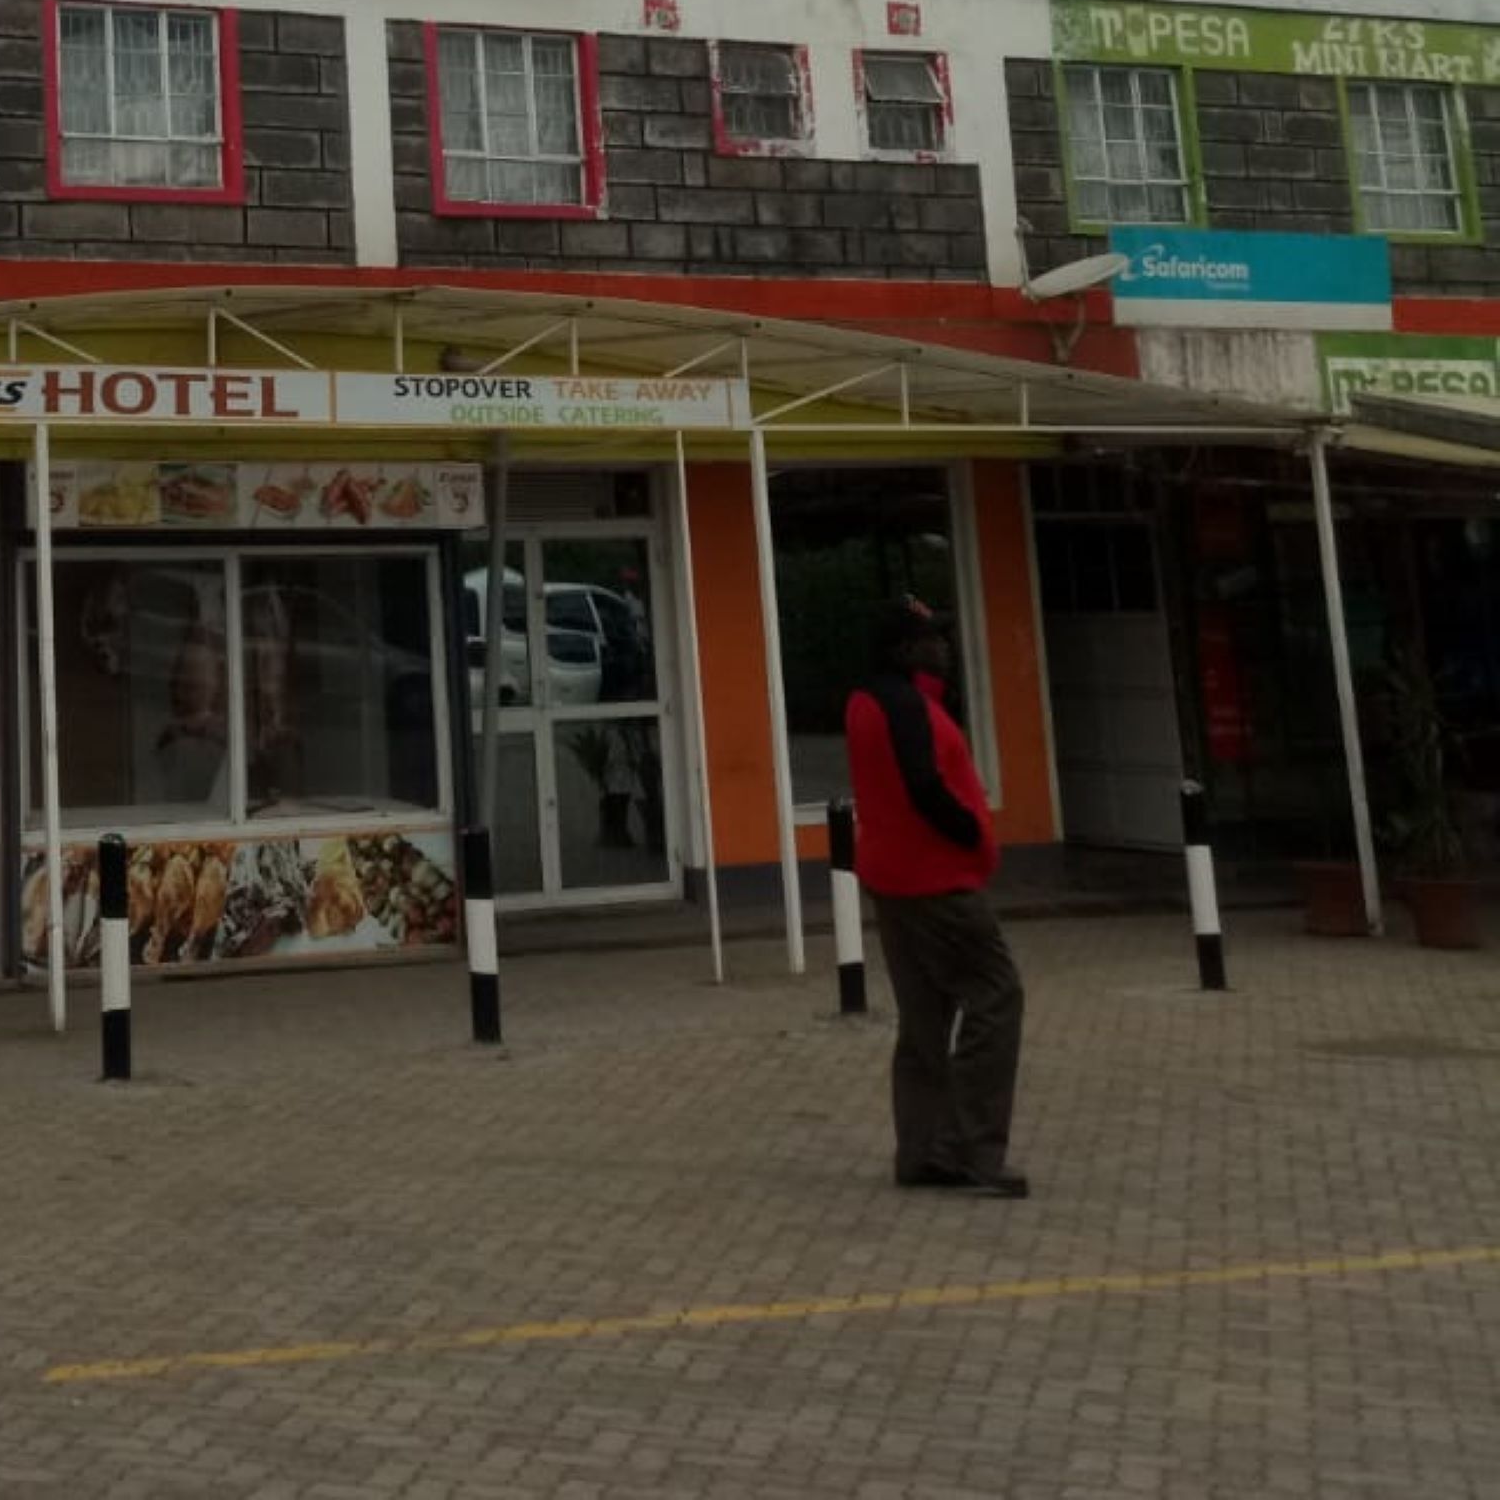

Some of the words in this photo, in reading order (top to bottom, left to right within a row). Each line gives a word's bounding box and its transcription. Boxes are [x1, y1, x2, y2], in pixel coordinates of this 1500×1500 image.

[1292, 40, 1368, 76] MINI
[1380, 48, 1474, 83] MART
[1141, 252, 1250, 280] Safaricom
[41, 370, 299, 419] HOTEL
[393, 375, 533, 400] STOPOVER
[552, 379, 620, 401] TAKE
[635, 380, 713, 402] AWAY
[451, 403, 545, 425] OUTSIDE
[558, 403, 665, 426] CATERING
